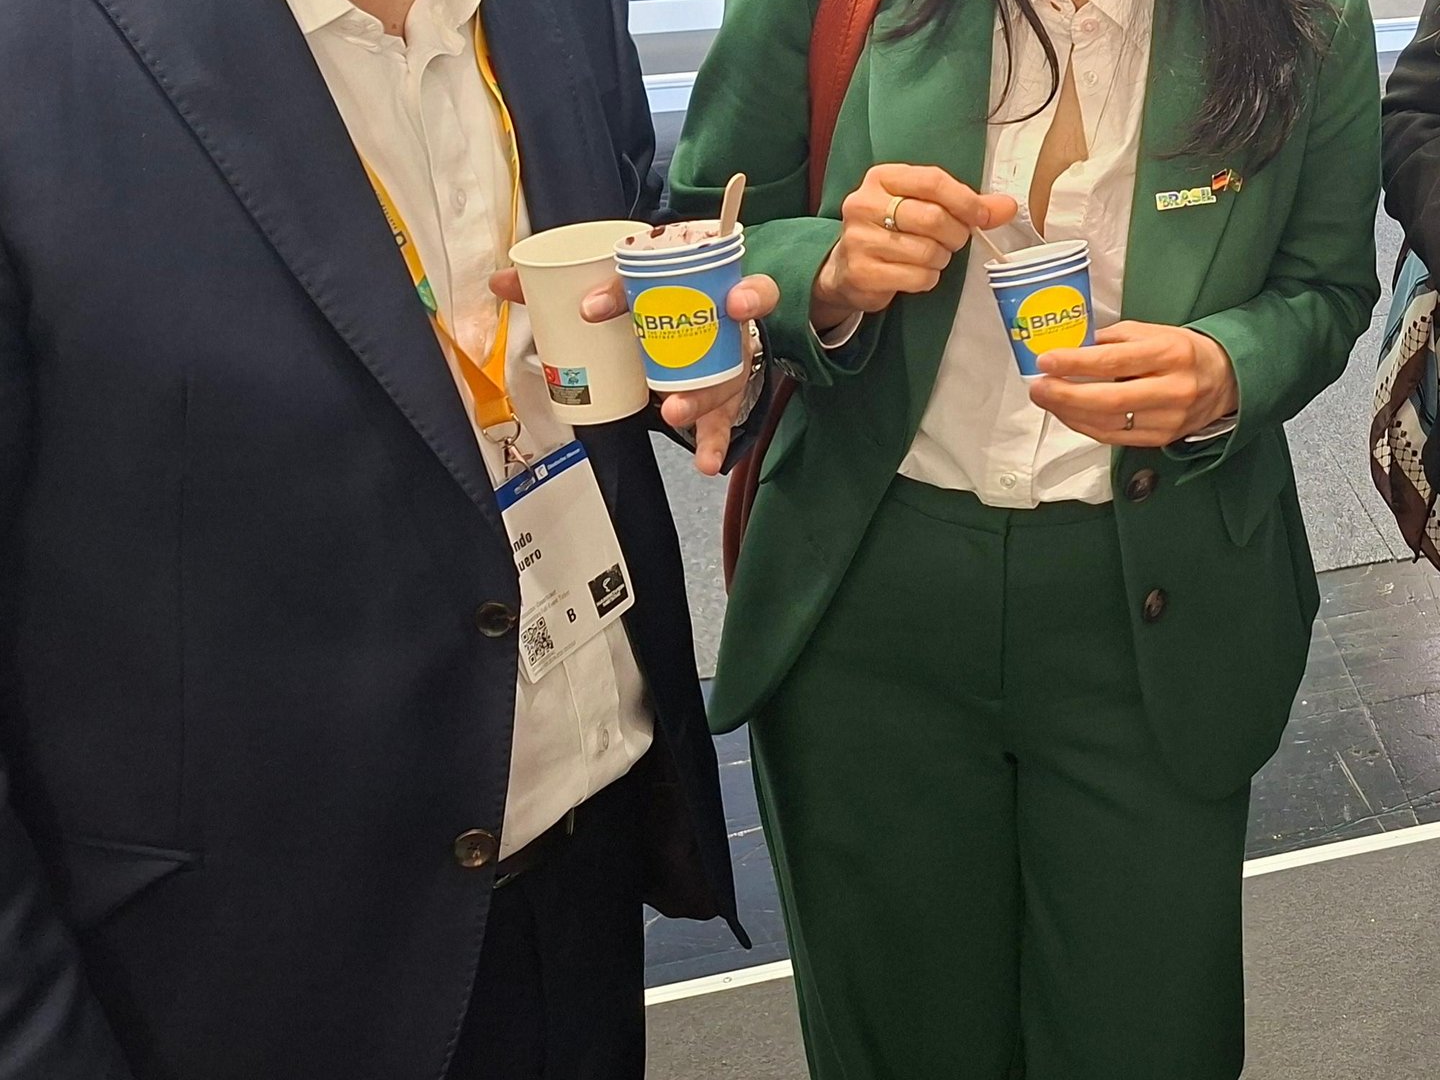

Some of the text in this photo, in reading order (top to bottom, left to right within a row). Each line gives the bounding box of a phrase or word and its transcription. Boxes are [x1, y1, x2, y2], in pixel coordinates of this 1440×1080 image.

[1031, 302, 1085, 330] BRASI
[513, 531, 533, 553] ndo
[518, 548, 542, 572] uero
[566, 607, 577, 623] B
